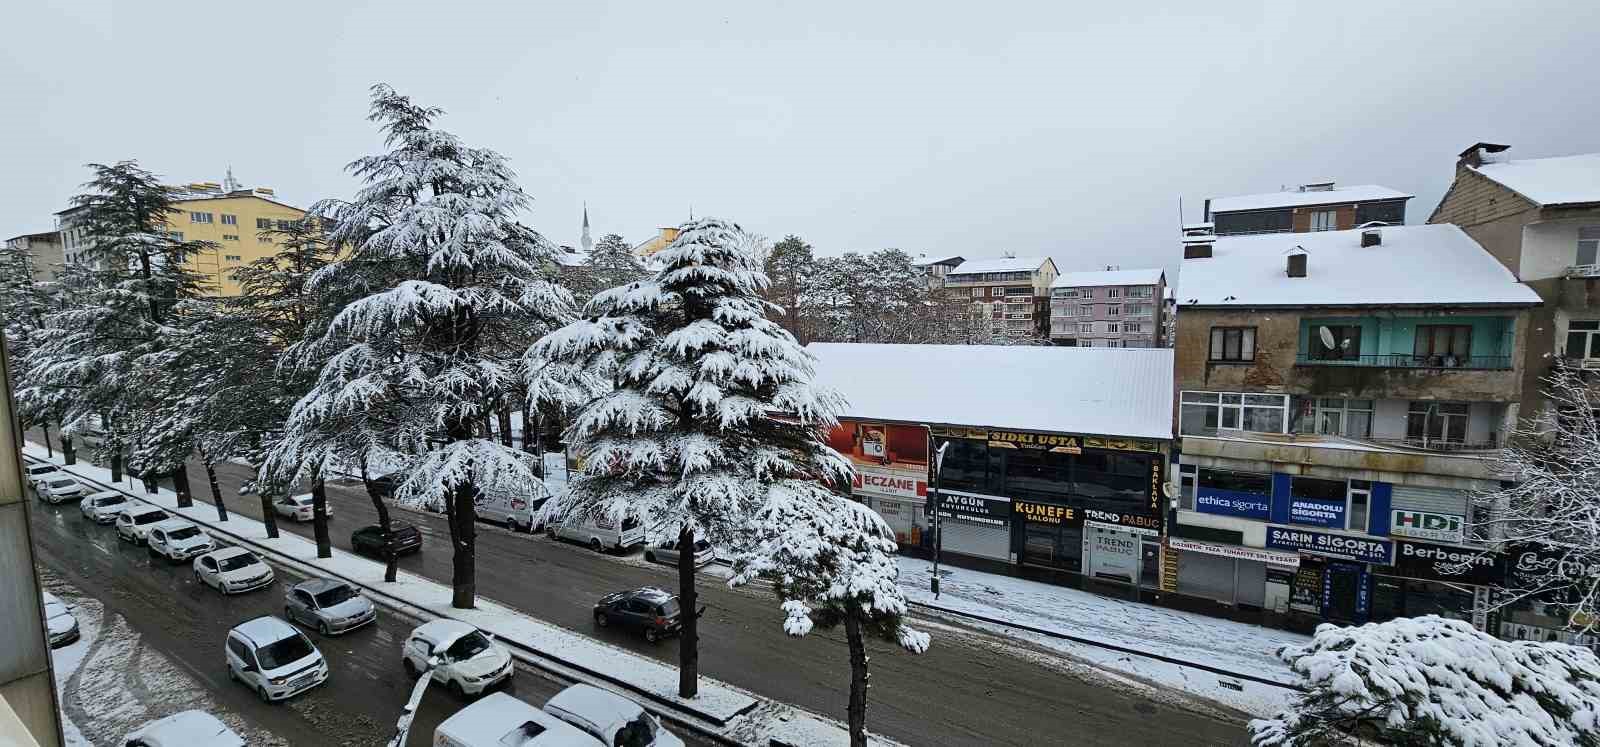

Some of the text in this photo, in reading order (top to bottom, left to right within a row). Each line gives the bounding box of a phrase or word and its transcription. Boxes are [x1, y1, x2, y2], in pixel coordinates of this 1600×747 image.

[1038, 435, 1078, 447] USTA
[864, 475, 913, 490] ECZANE
[1151, 465, 1159, 509] BAKLAVA
[1015, 502, 1074, 519] KÜNEFE
[1198, 496, 1268, 511] ethica sigorta
[1292, 502, 1343, 512] ANADOLU
[1026, 514, 1061, 524] SALONU
[1084, 510, 1120, 522] TREND
[1097, 536, 1134, 549] TREND
[1272, 530, 1385, 553] SARIN SİGORTA
[1402, 543, 1495, 567] Berberim
